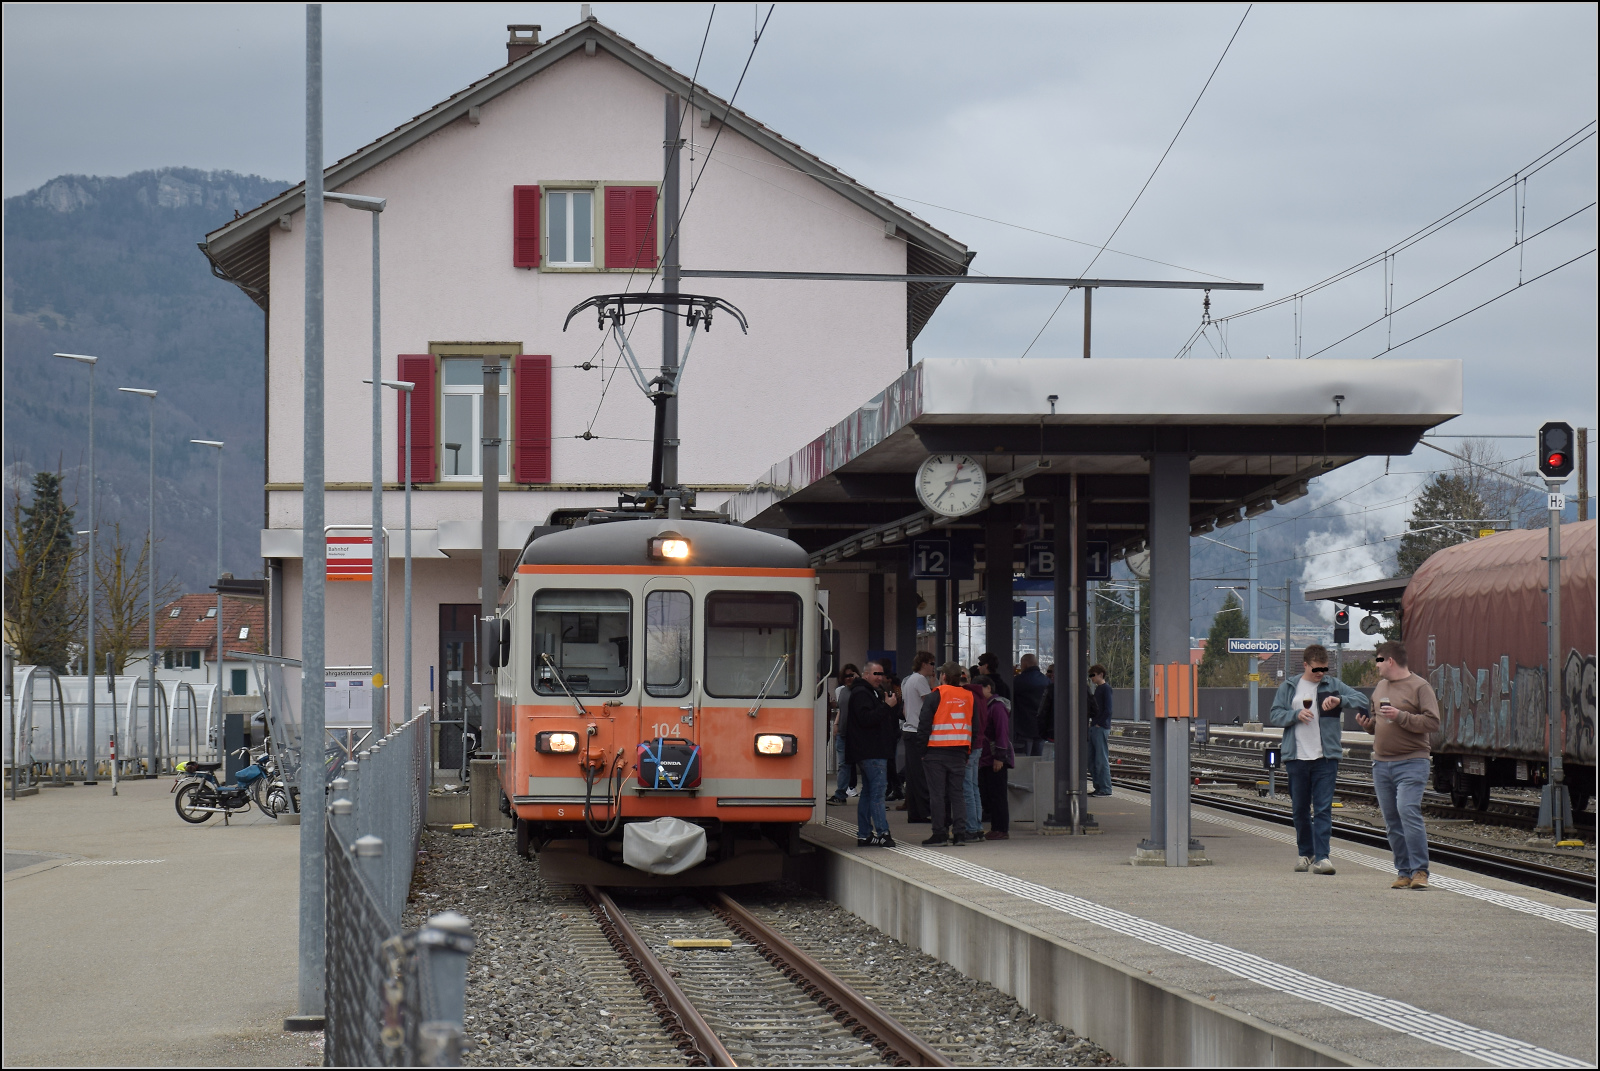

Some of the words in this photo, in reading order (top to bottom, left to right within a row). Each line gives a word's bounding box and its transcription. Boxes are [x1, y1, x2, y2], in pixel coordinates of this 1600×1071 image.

[918, 550, 945, 572] 12
[1038, 551, 1055, 573] B
[1091, 551, 1101, 573] 1
[1230, 640, 1279, 651] Niederbipp
[651, 723, 681, 738] 104
[557, 808, 565, 817] S
